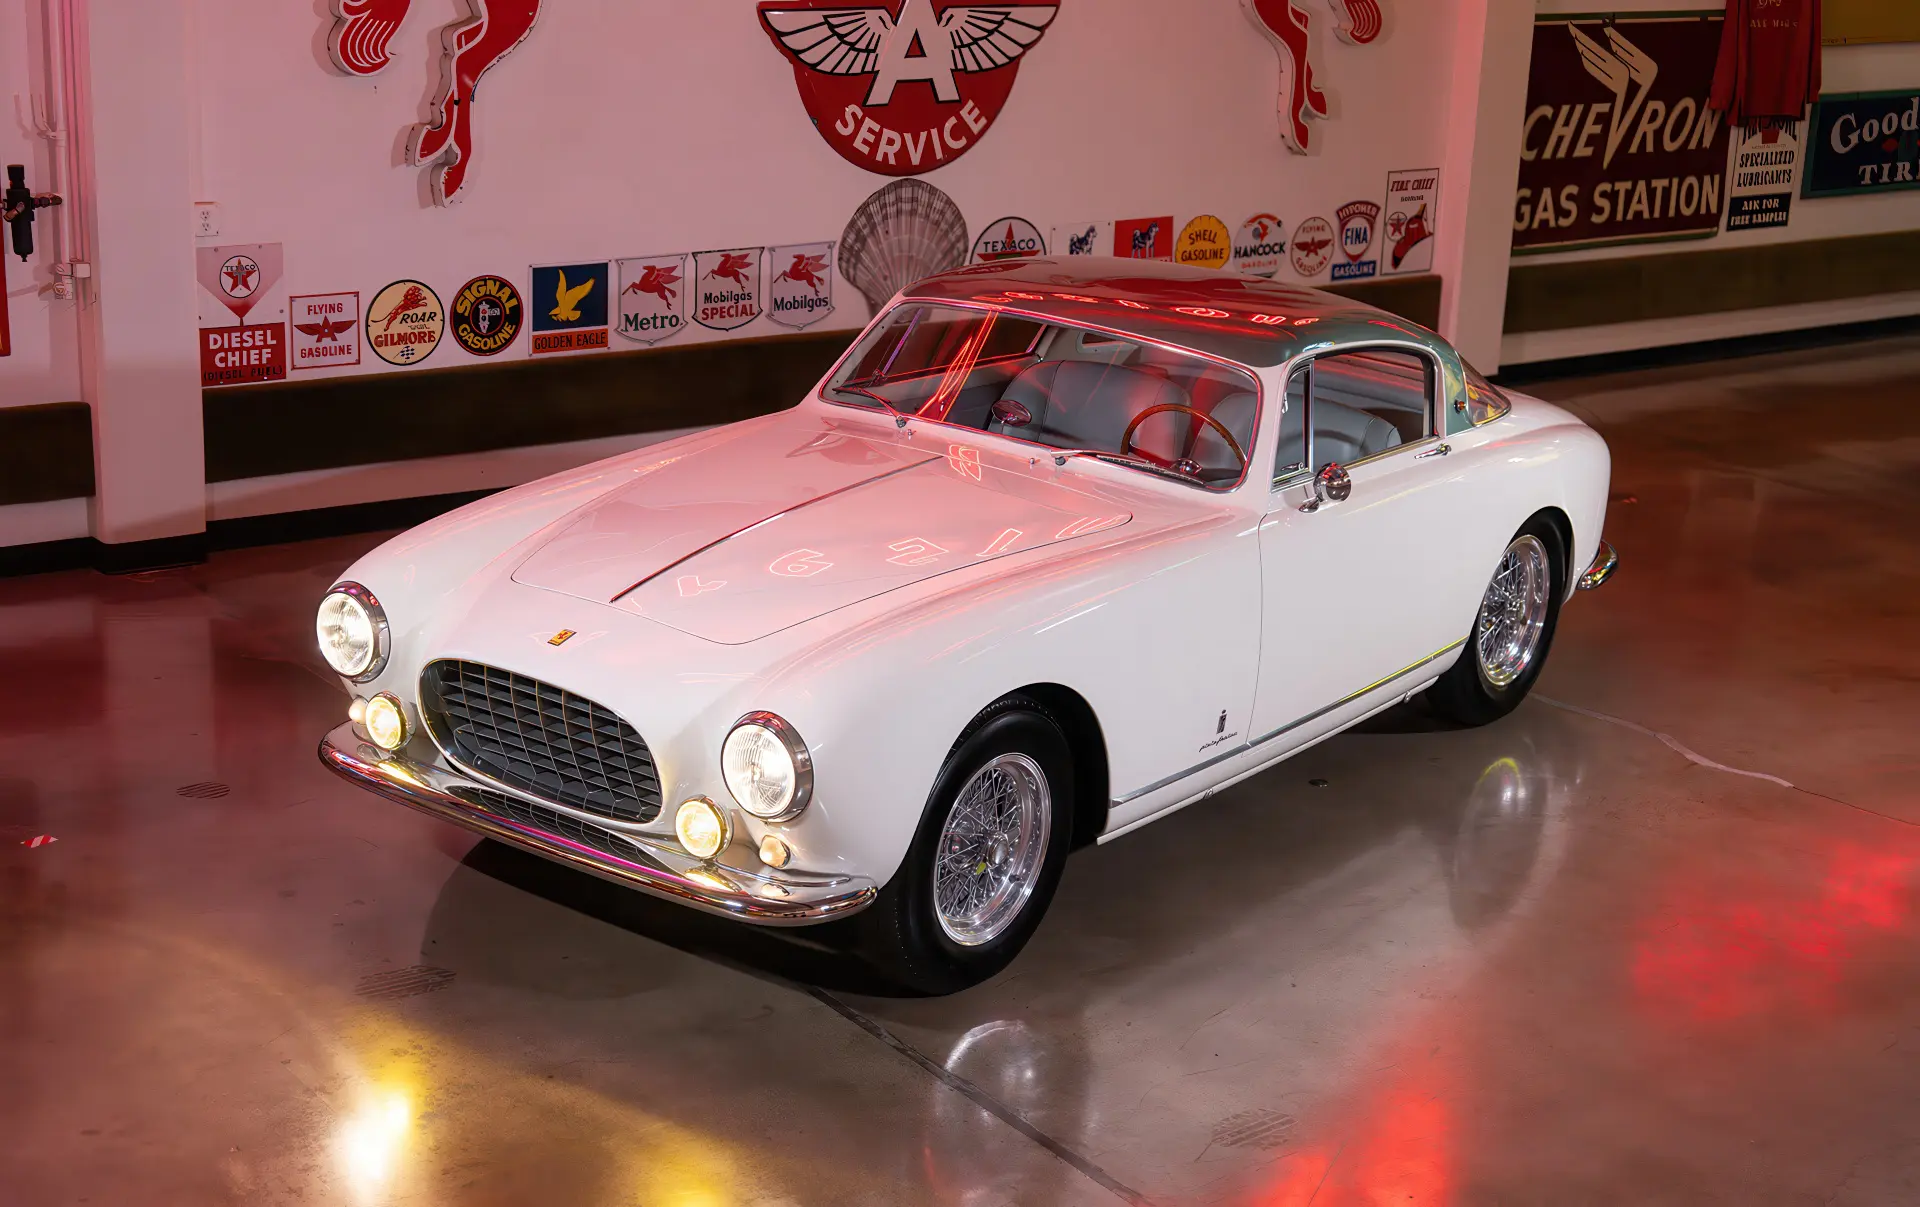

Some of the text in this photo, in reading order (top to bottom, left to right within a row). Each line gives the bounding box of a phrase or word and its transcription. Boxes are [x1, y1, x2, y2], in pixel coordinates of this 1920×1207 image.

[835, 100, 987, 165] SERVICE
[1520, 84, 1724, 169] CHEVRON
[1737, 169, 1792, 187] LUBRICANTS
[1858, 162, 1920, 185] TIR
[1513, 174, 1720, 231] GAS STATION
[1188, 229, 1217, 245] SHELL
[1345, 226, 1368, 245] FINA
[983, 239, 1036, 253] TEXACO
[1181, 248, 1224, 262] GASOLINE
[1234, 241, 1286, 259] HANCOCK
[224, 264, 256, 272] TEXACO
[1334, 263, 1374, 277] GASOLINE
[456, 279, 518, 317] SIGNAL
[703, 291, 752, 305] Mobilgas
[773, 295, 829, 312] Mobilgas
[307, 303, 343, 316] FLYING
[399, 311, 437, 324] ROAR
[701, 303, 755, 320] SPECIAL
[623, 313, 680, 332] Metro
[208, 330, 277, 350] DIESEL
[374, 330, 436, 348] GILMORE
[458, 321, 516, 350] GASOLINE
[534, 331, 607, 350] GOLDEN EAGLE
[214, 349, 272, 368] CHIEF
[300, 344, 352, 359] GASOLINE
